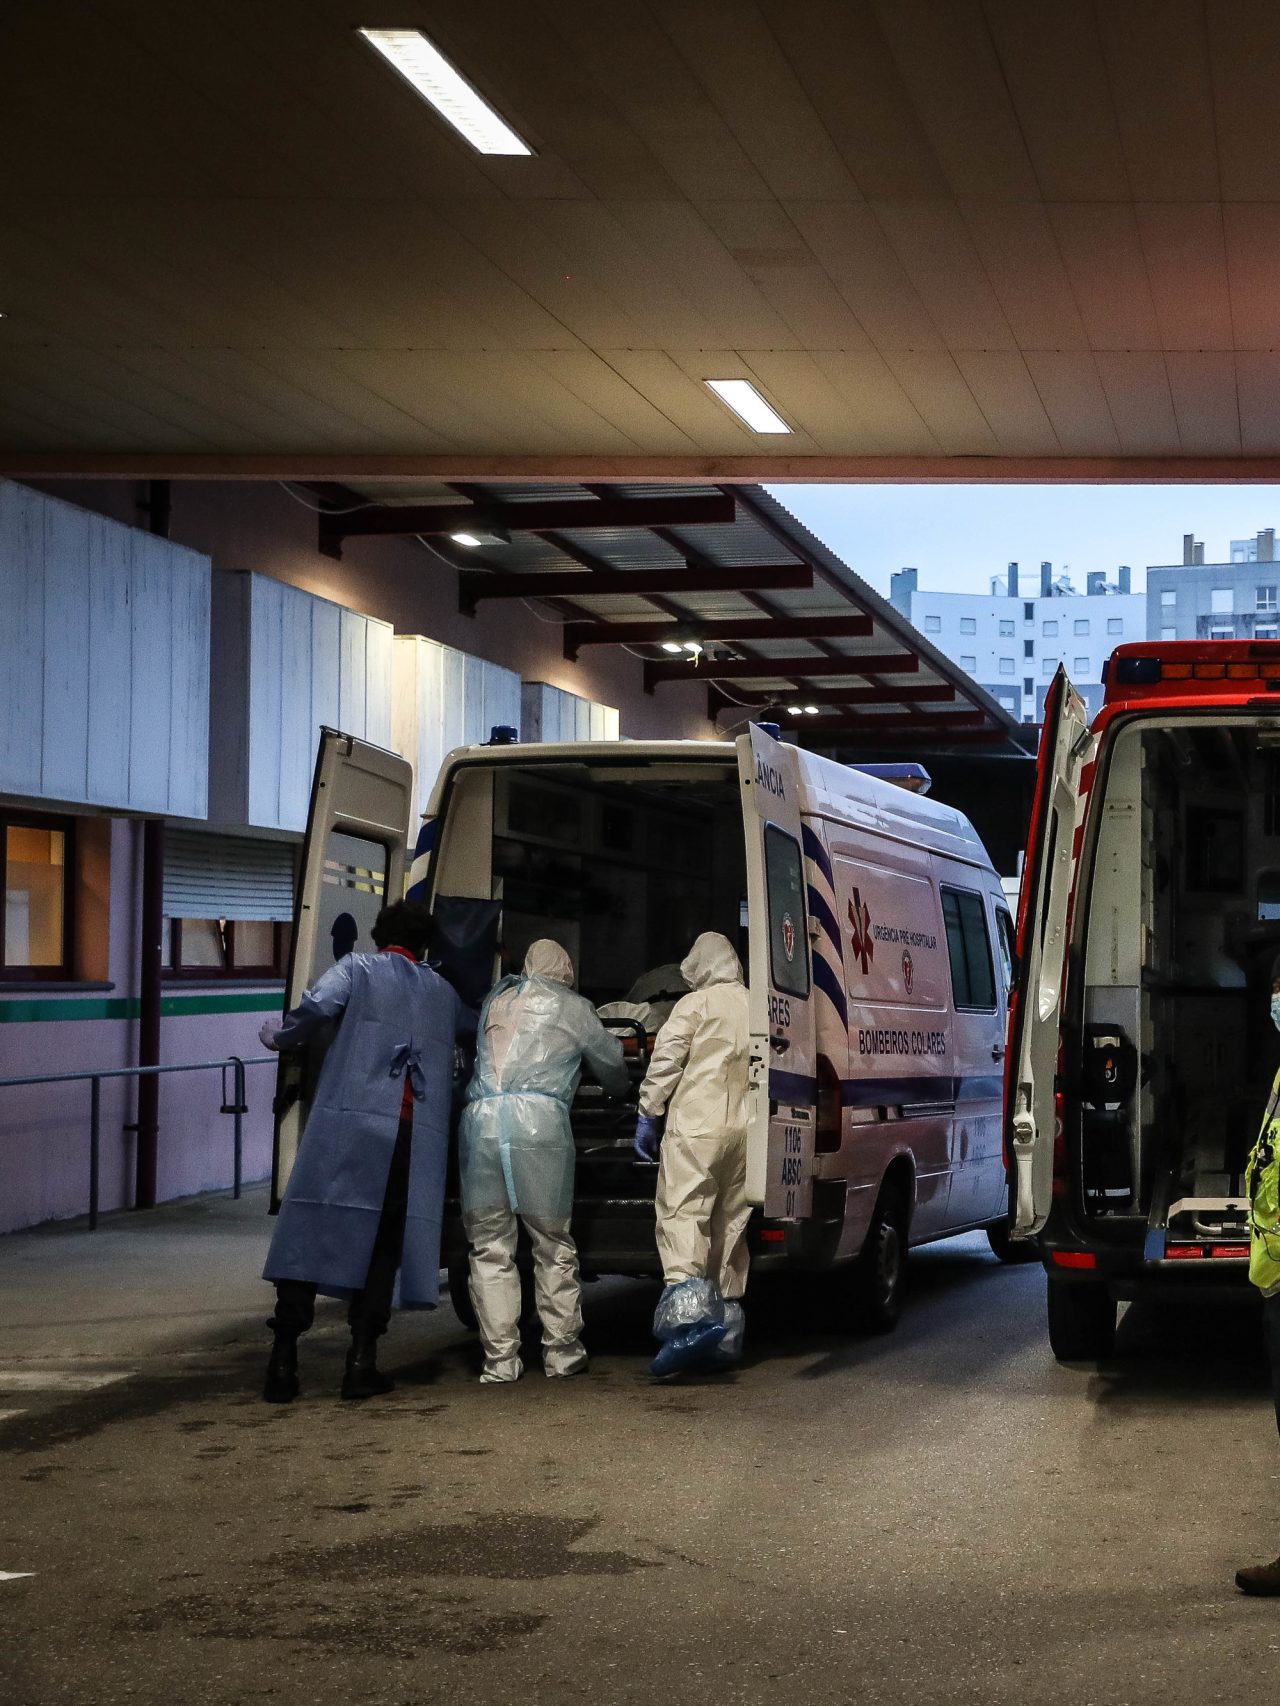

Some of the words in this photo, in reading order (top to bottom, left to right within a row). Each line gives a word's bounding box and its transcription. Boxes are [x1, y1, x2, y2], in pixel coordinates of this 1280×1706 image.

[755, 752, 786, 800] ÂNCIA
[859, 1029, 909, 1055] BOMBEIROS
[911, 1031, 946, 1055] COLARES
[781, 1157, 802, 1186] ABSC
